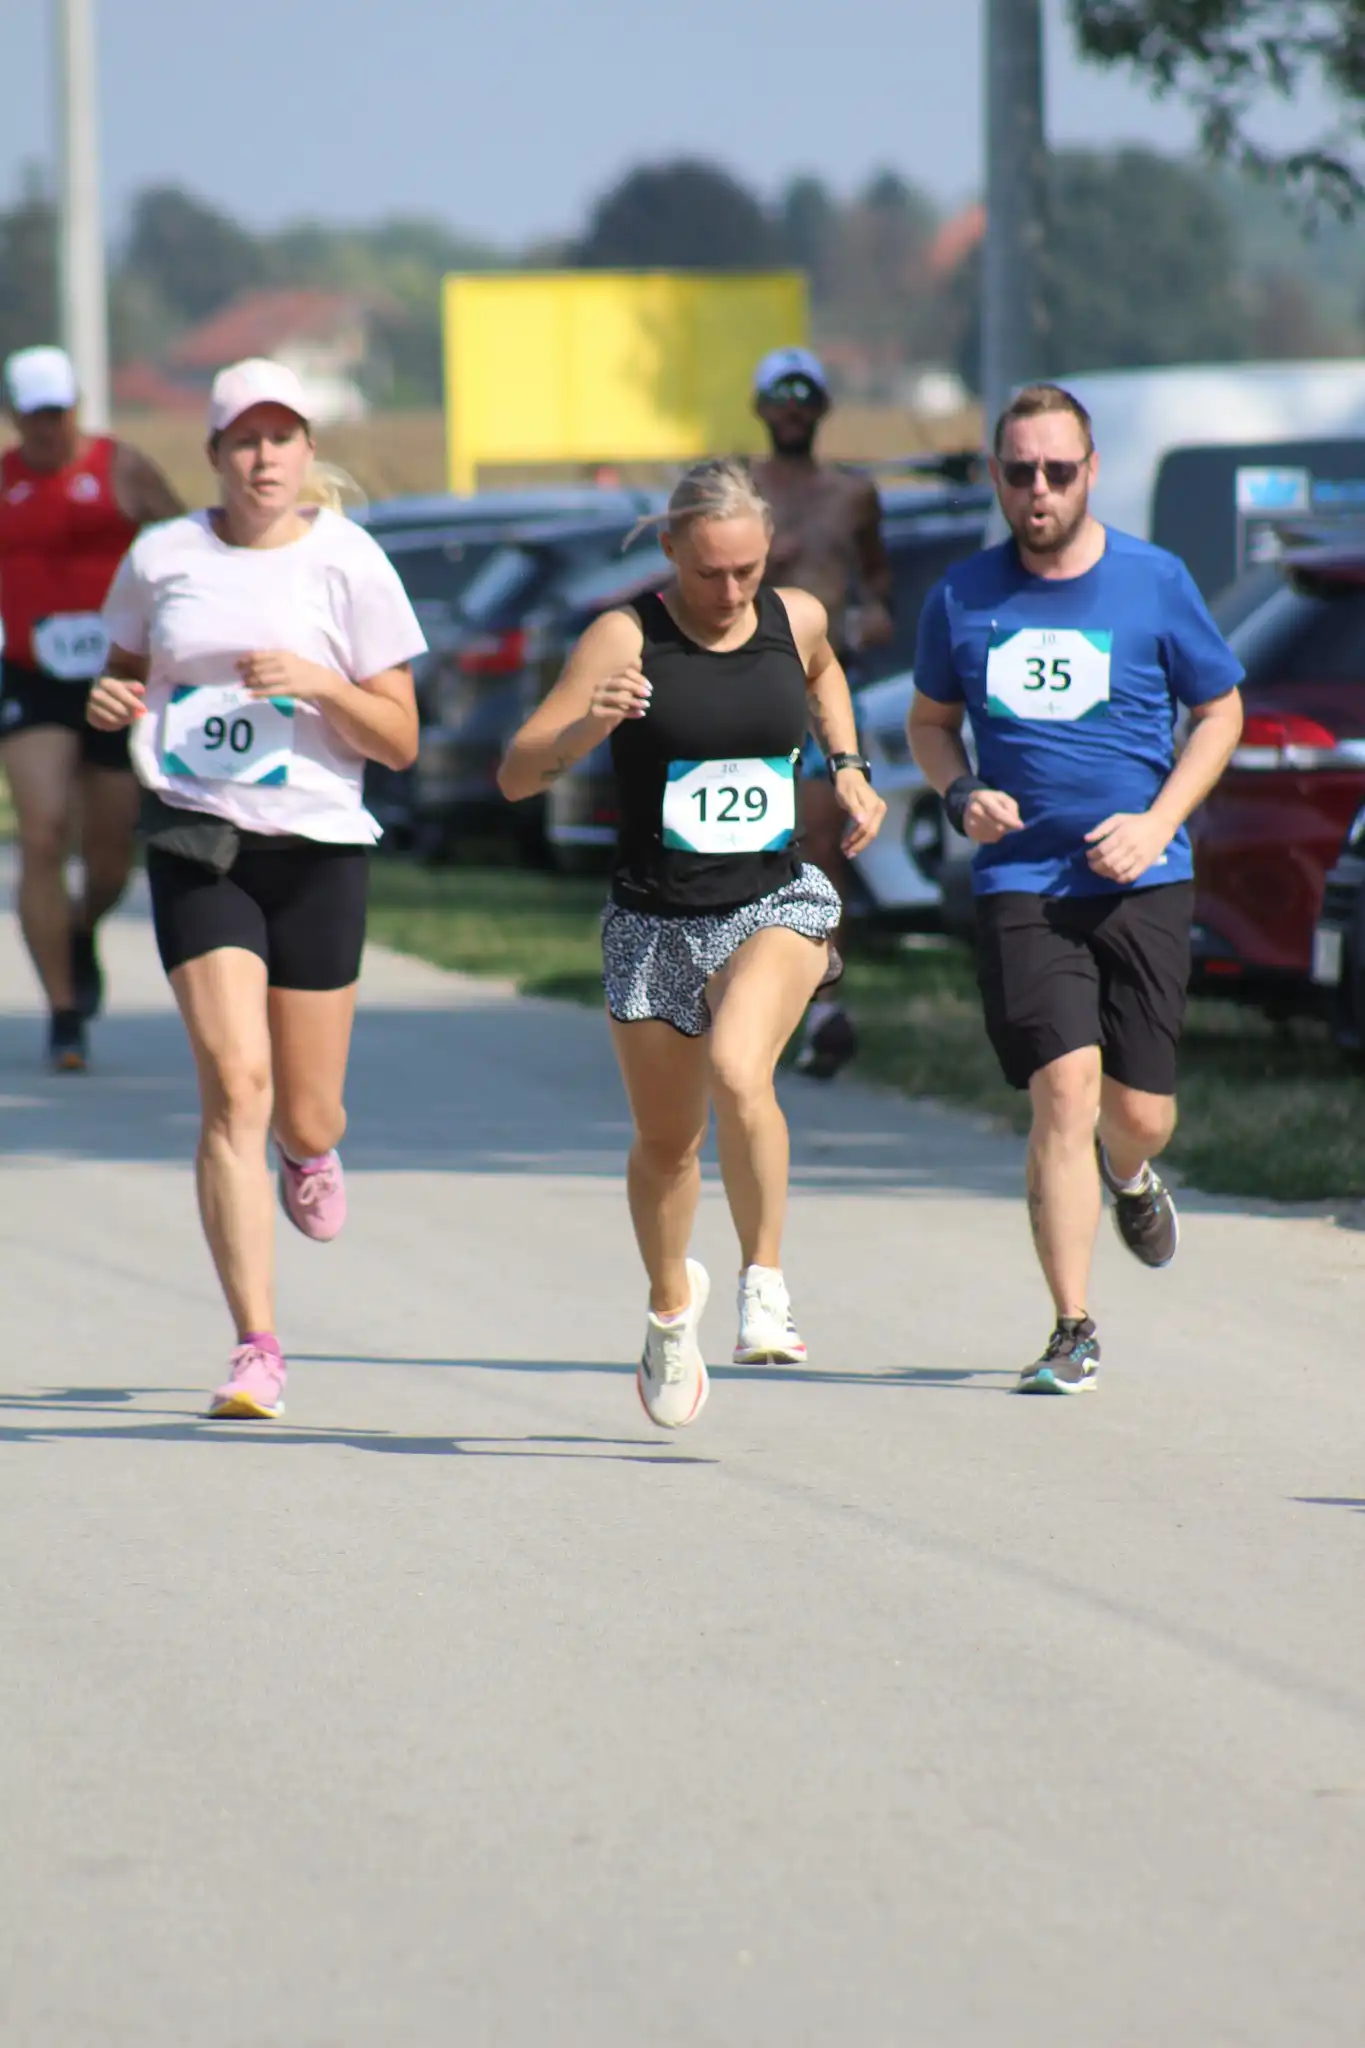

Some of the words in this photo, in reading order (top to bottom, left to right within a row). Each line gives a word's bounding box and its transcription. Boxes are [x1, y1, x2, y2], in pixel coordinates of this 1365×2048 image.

[1023, 657, 1072, 692] 35
[203, 716, 255, 754] 90
[691, 786, 768, 822] 129
